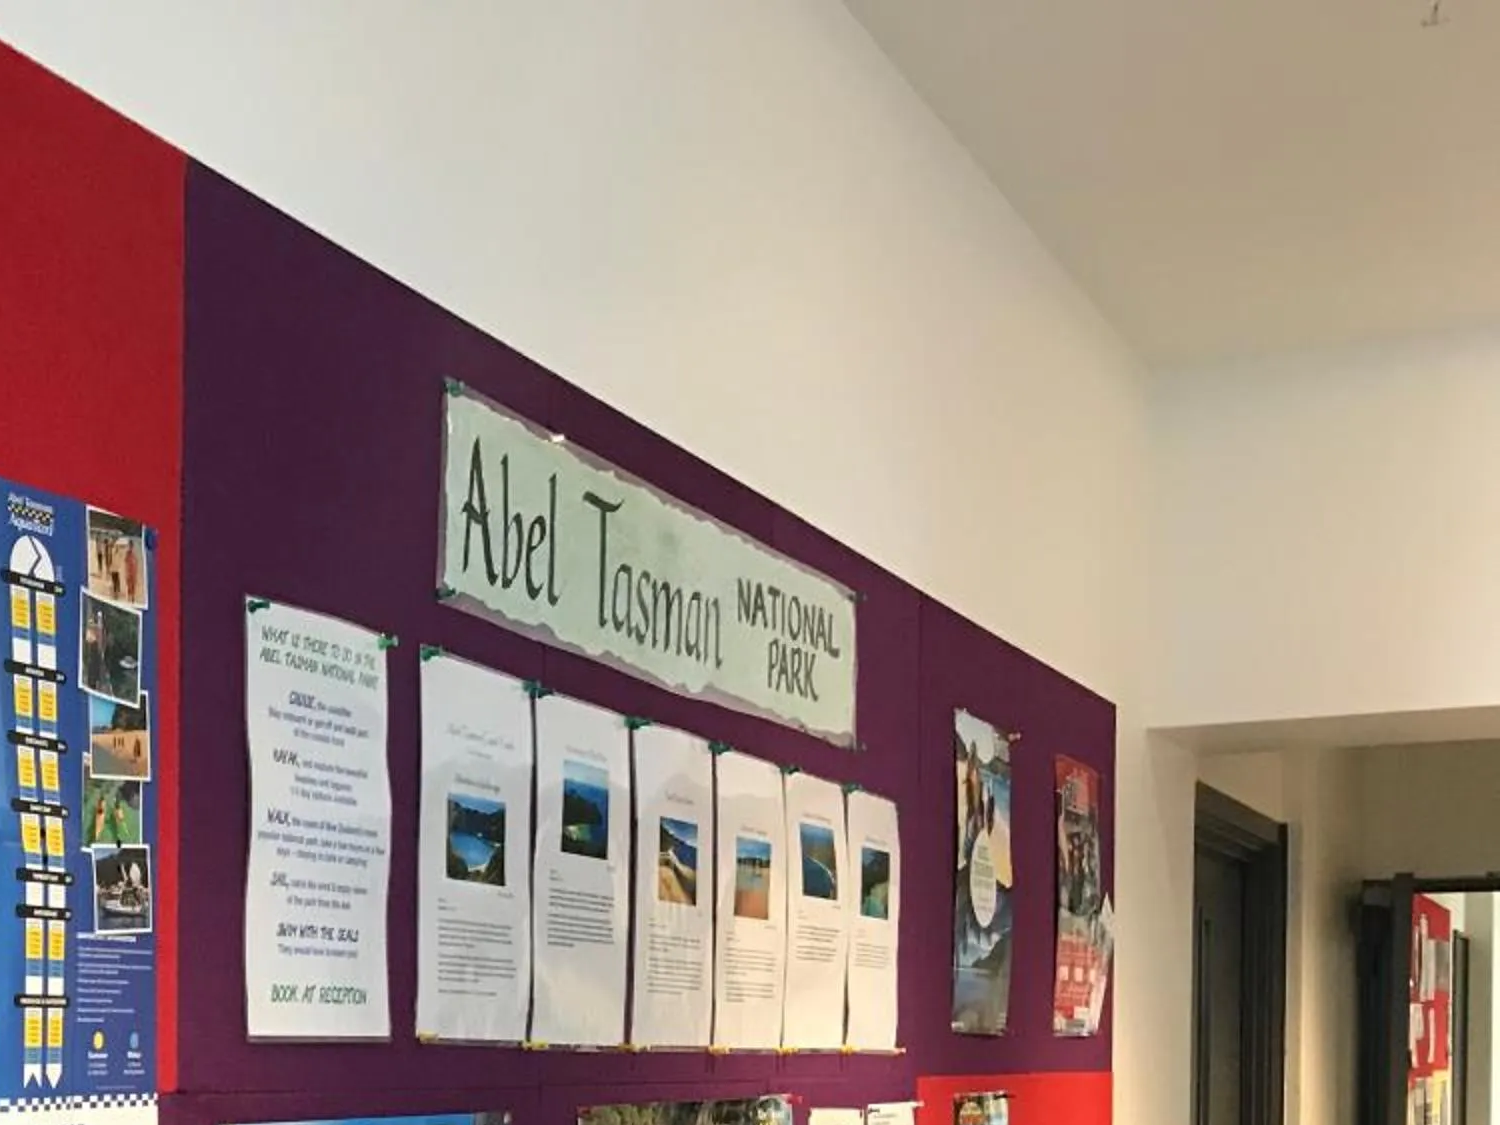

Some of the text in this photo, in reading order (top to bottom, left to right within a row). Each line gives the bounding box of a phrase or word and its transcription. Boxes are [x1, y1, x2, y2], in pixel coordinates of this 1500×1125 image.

[462, 436, 723, 670] Abel Tasman
[737, 577, 840, 659] NATIONAL
[768, 638, 818, 702] PARK
[271, 983, 367, 1005] BOOK AT RECEPTION
